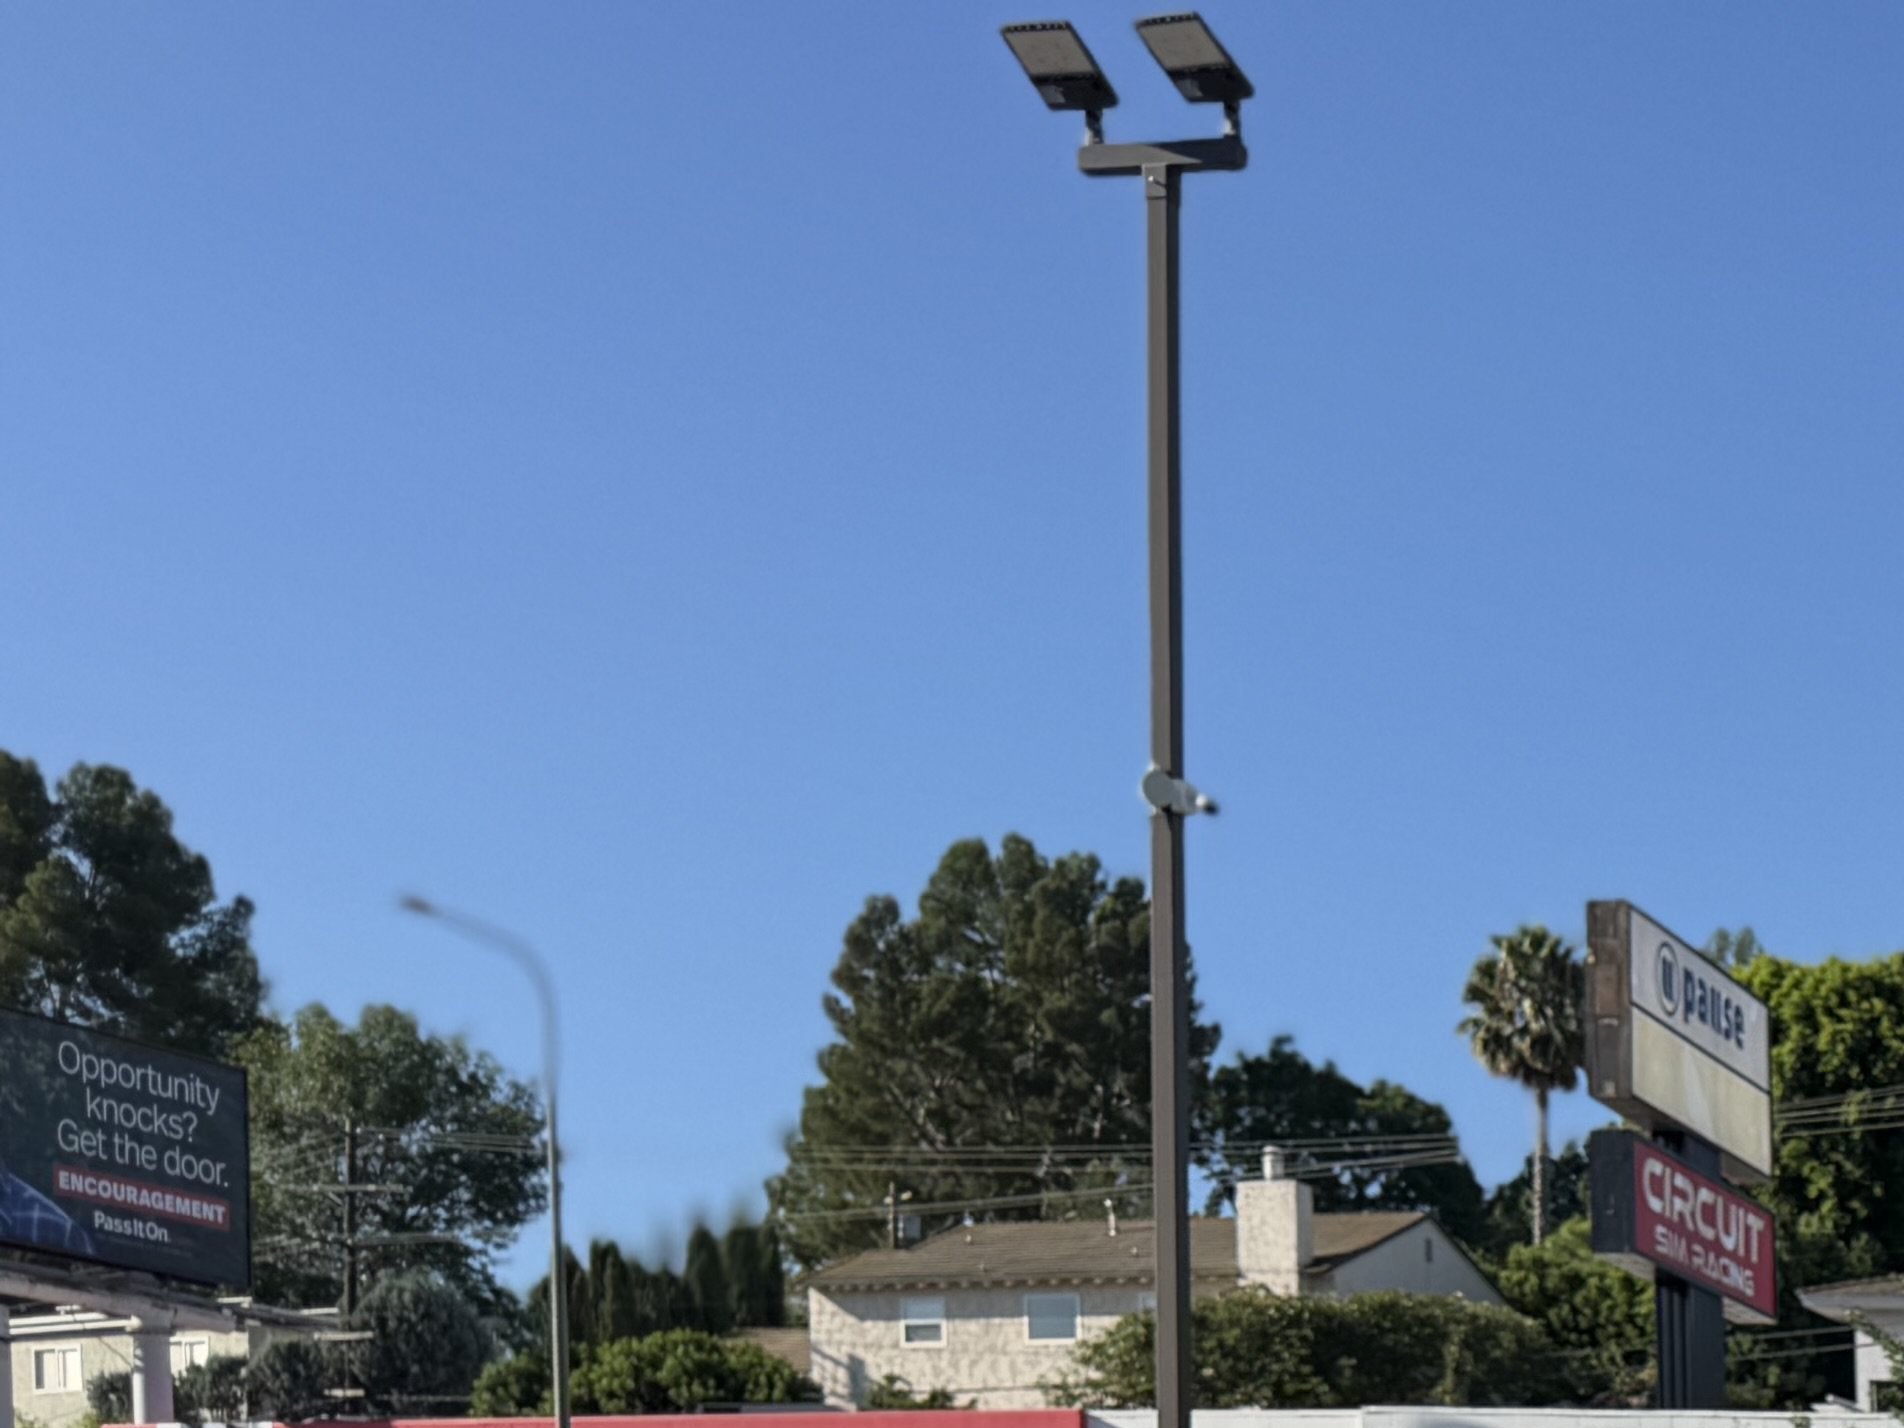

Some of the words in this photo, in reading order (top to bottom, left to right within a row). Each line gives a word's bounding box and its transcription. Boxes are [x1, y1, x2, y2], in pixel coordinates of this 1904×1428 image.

[1683, 966, 1745, 1051] pause
[58, 1041, 220, 1116] Opportunity
[86, 1086, 198, 1142] knocks?
[57, 1118, 108, 1161] Get
[113, 1131, 157, 1171] the
[163, 1145, 229, 1188] door.
[58, 1170, 226, 1223] ENCOURAGEMENT
[1643, 1157, 1765, 1264] CIRCUIT
[1654, 1223, 1689, 1266] SIM
[1690, 1243, 1755, 1297] RACING
